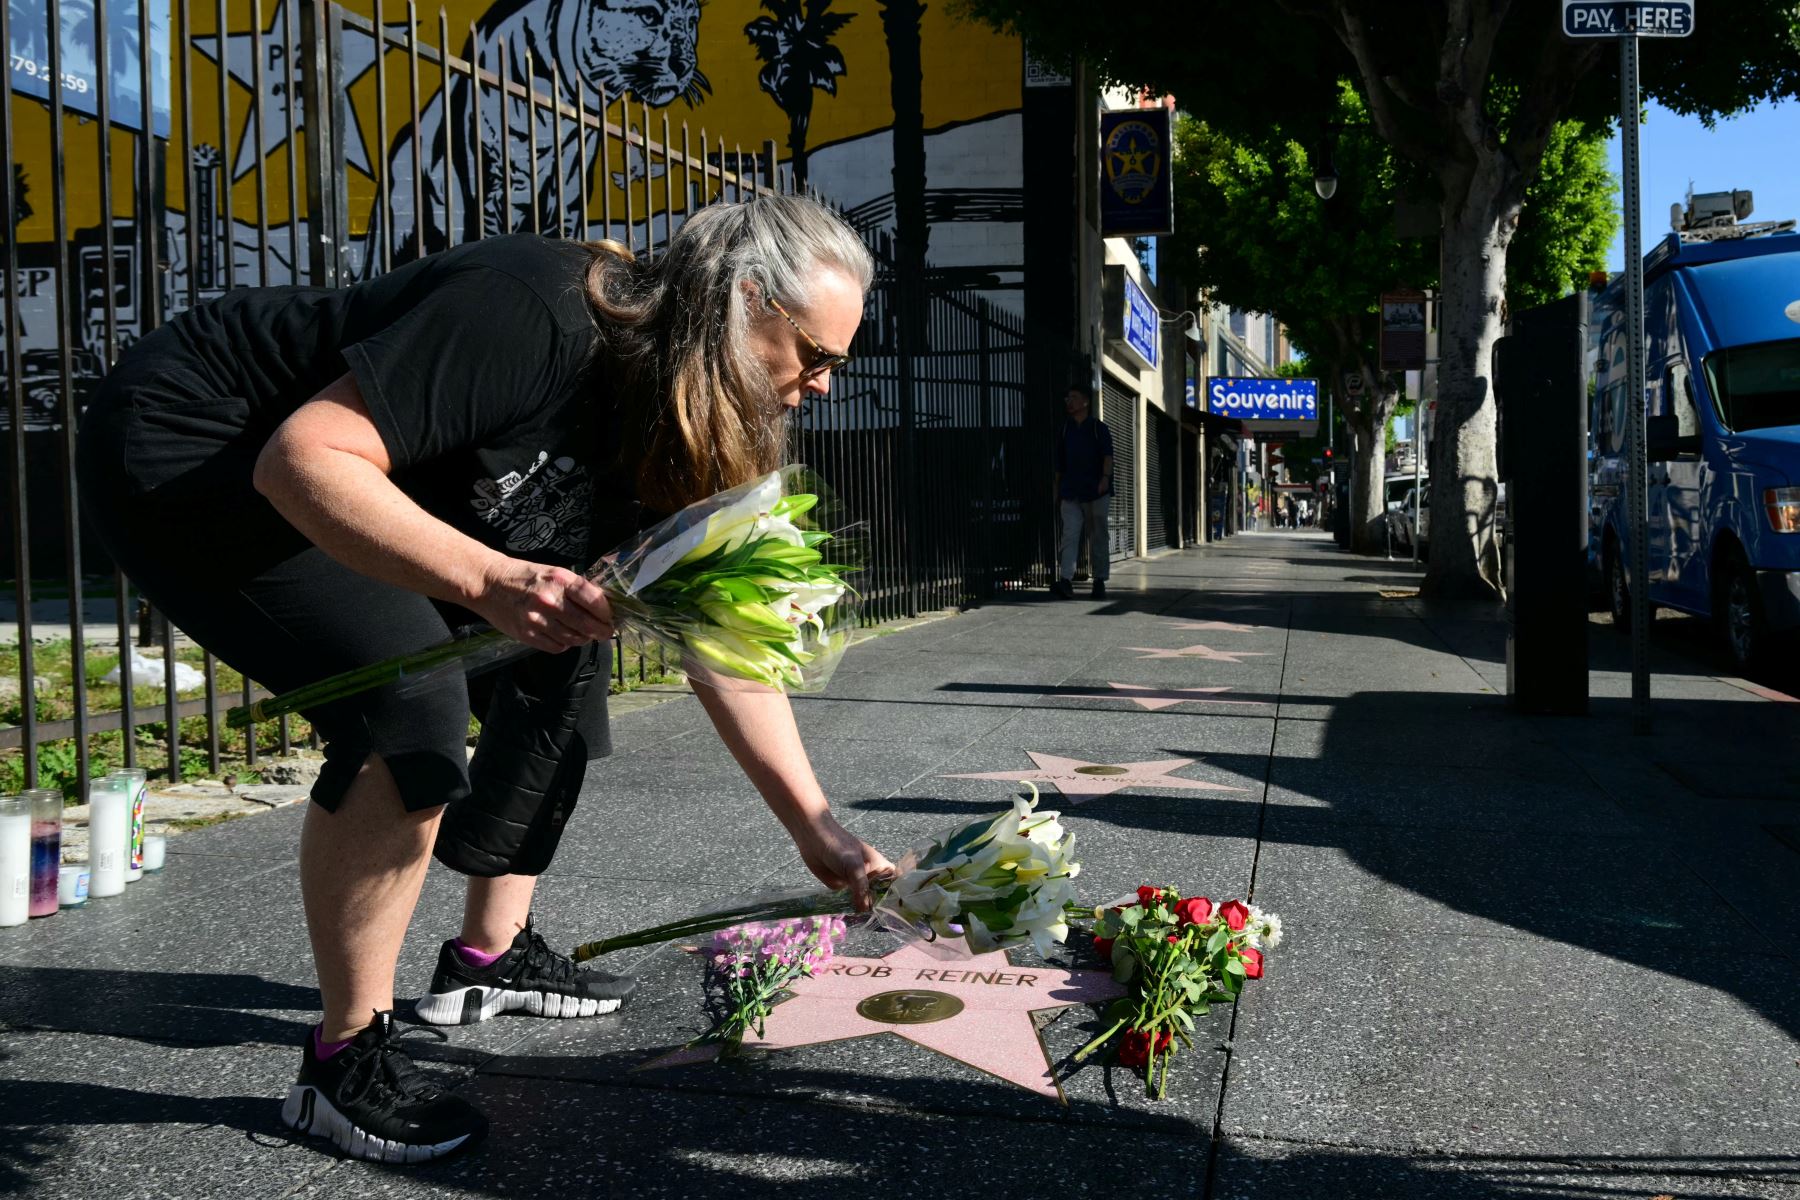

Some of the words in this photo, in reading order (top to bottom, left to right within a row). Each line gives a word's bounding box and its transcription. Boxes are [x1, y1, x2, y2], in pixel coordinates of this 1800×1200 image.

[1574, 8, 1613, 28] PAY
[1625, 7, 1683, 28] HERE
[1212, 384, 1316, 410] Souvenirs
[827, 963, 892, 978] ROB
[915, 968, 1038, 987] REINER
